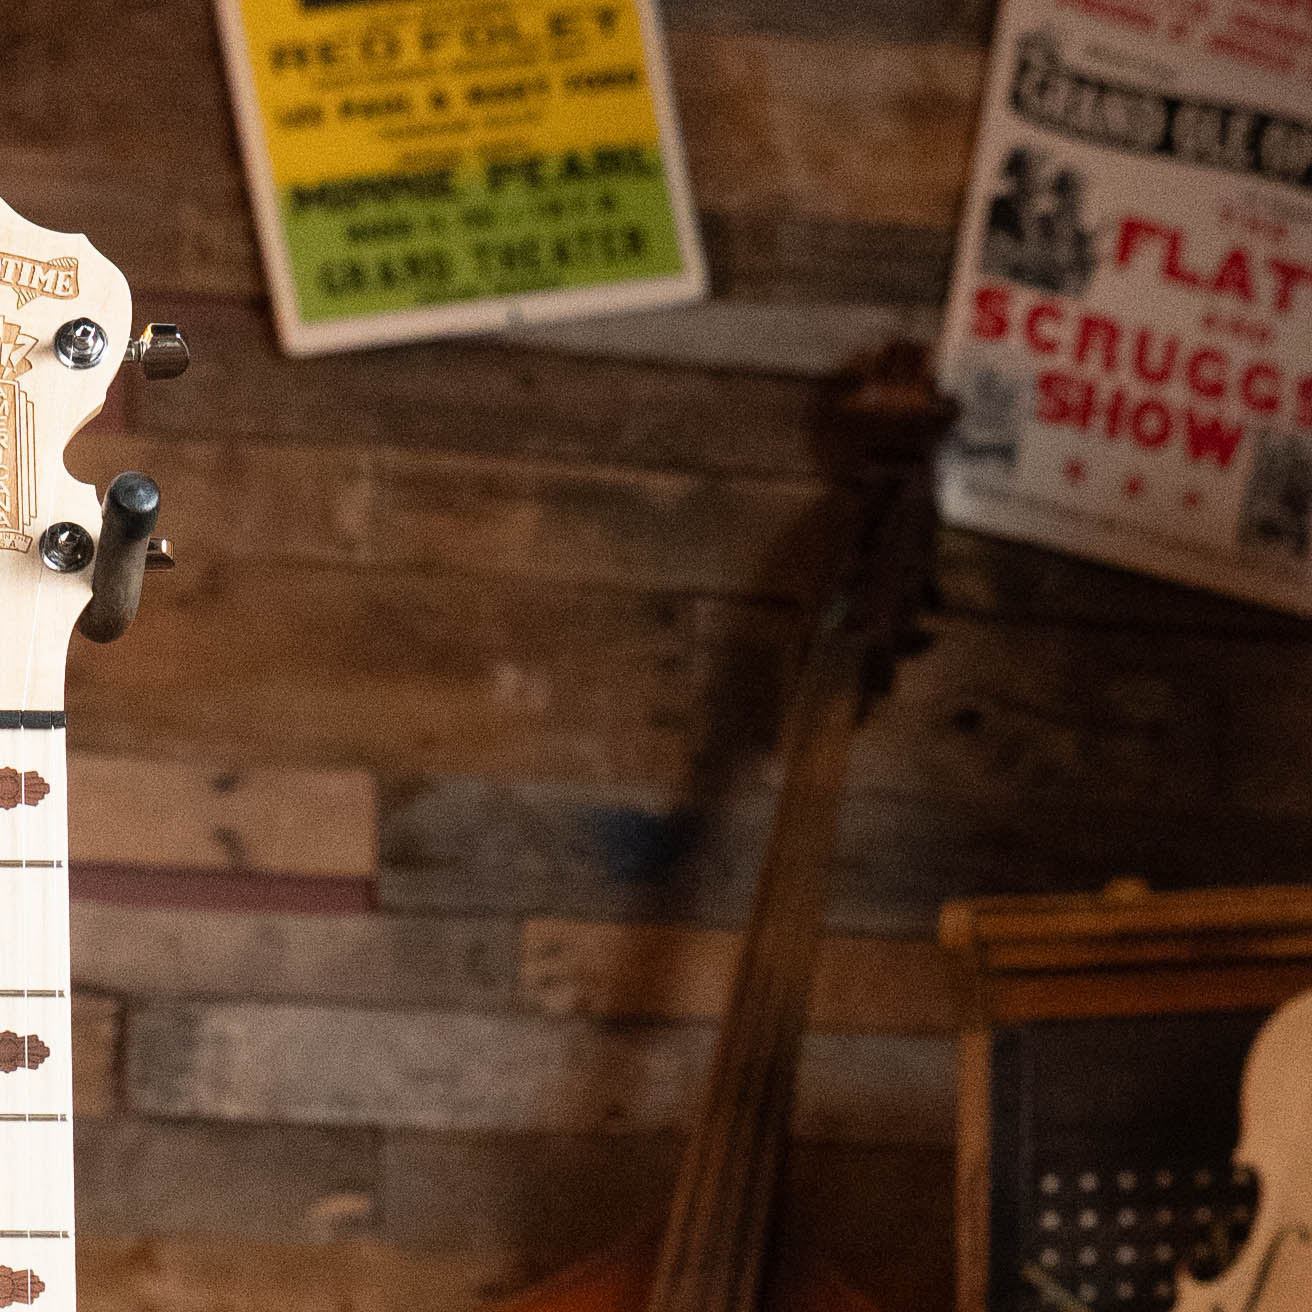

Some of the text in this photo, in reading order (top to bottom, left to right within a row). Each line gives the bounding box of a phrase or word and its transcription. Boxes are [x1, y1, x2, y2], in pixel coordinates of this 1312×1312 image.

[315, 250, 452, 298] GRAND
[470, 222, 647, 280] THEATER
[1036, 370, 1246, 471] SHOW
